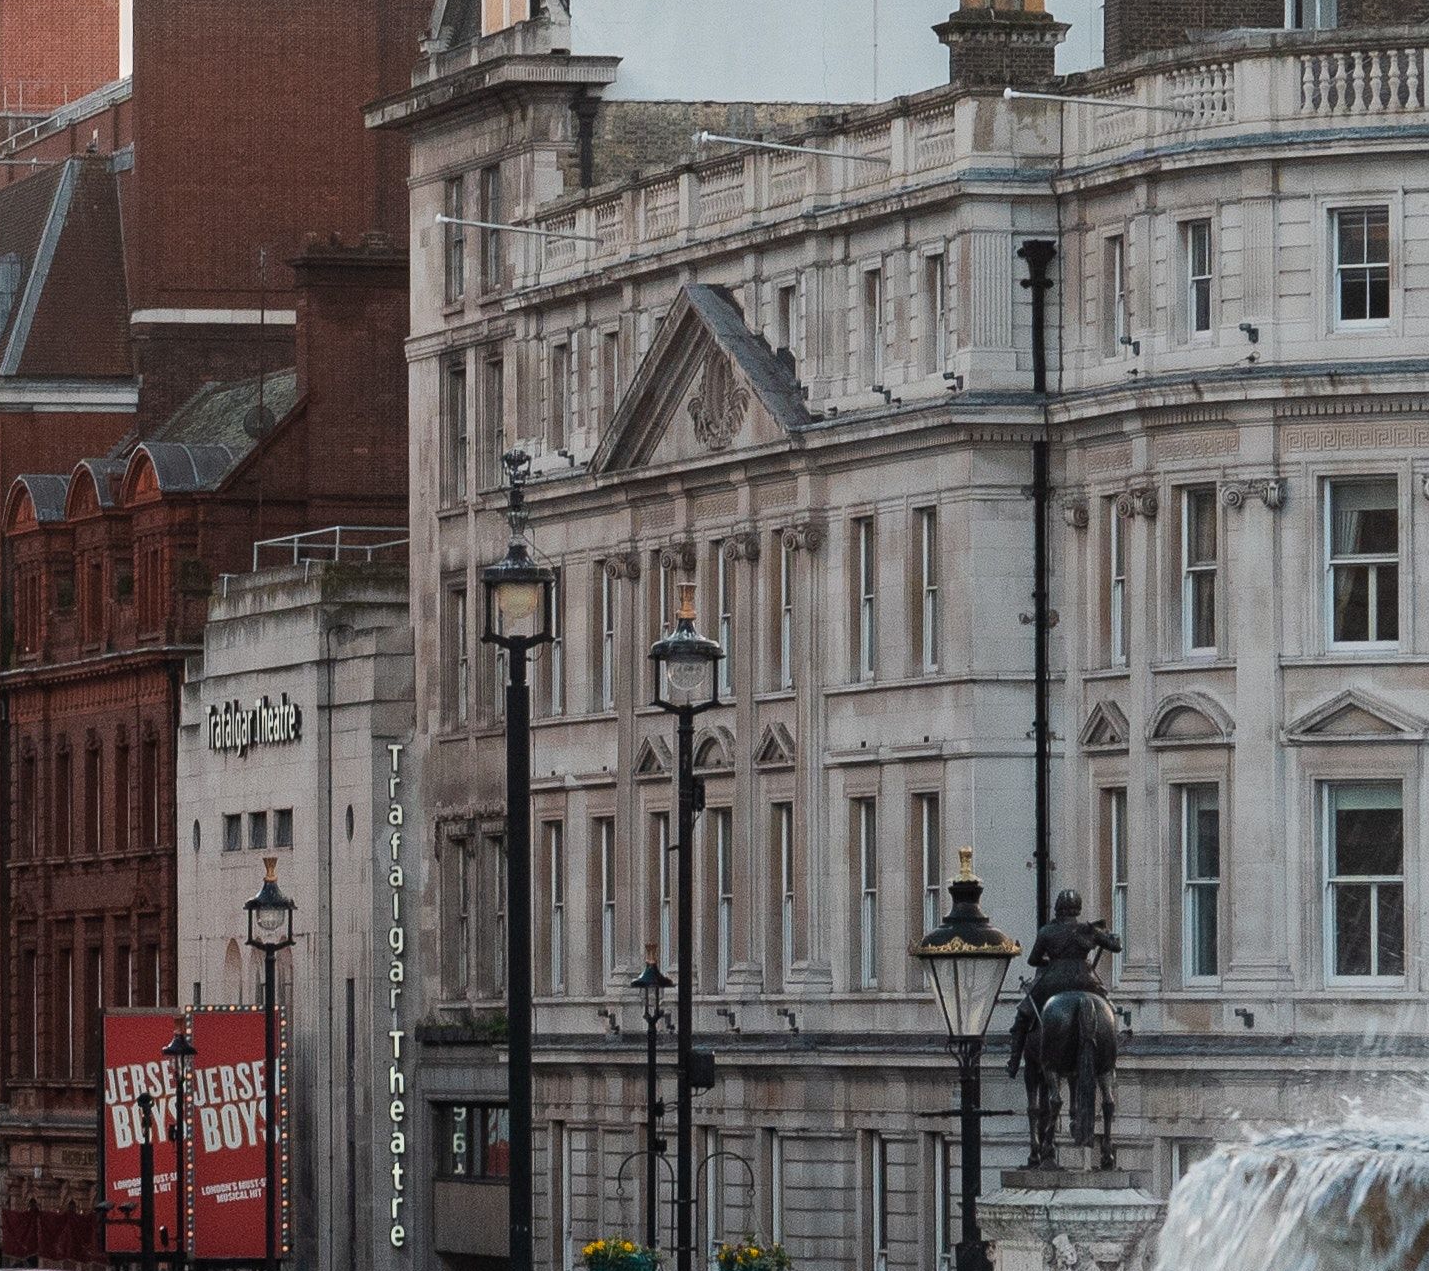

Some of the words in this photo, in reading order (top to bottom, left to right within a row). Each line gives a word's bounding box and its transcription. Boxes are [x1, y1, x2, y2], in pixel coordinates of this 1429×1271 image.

[205, 700, 254, 758] Trafalgar
[255, 693, 297, 744] Theatre
[387, 744, 404, 1009] Trafalgar
[388, 1031, 405, 1247] Theatre
